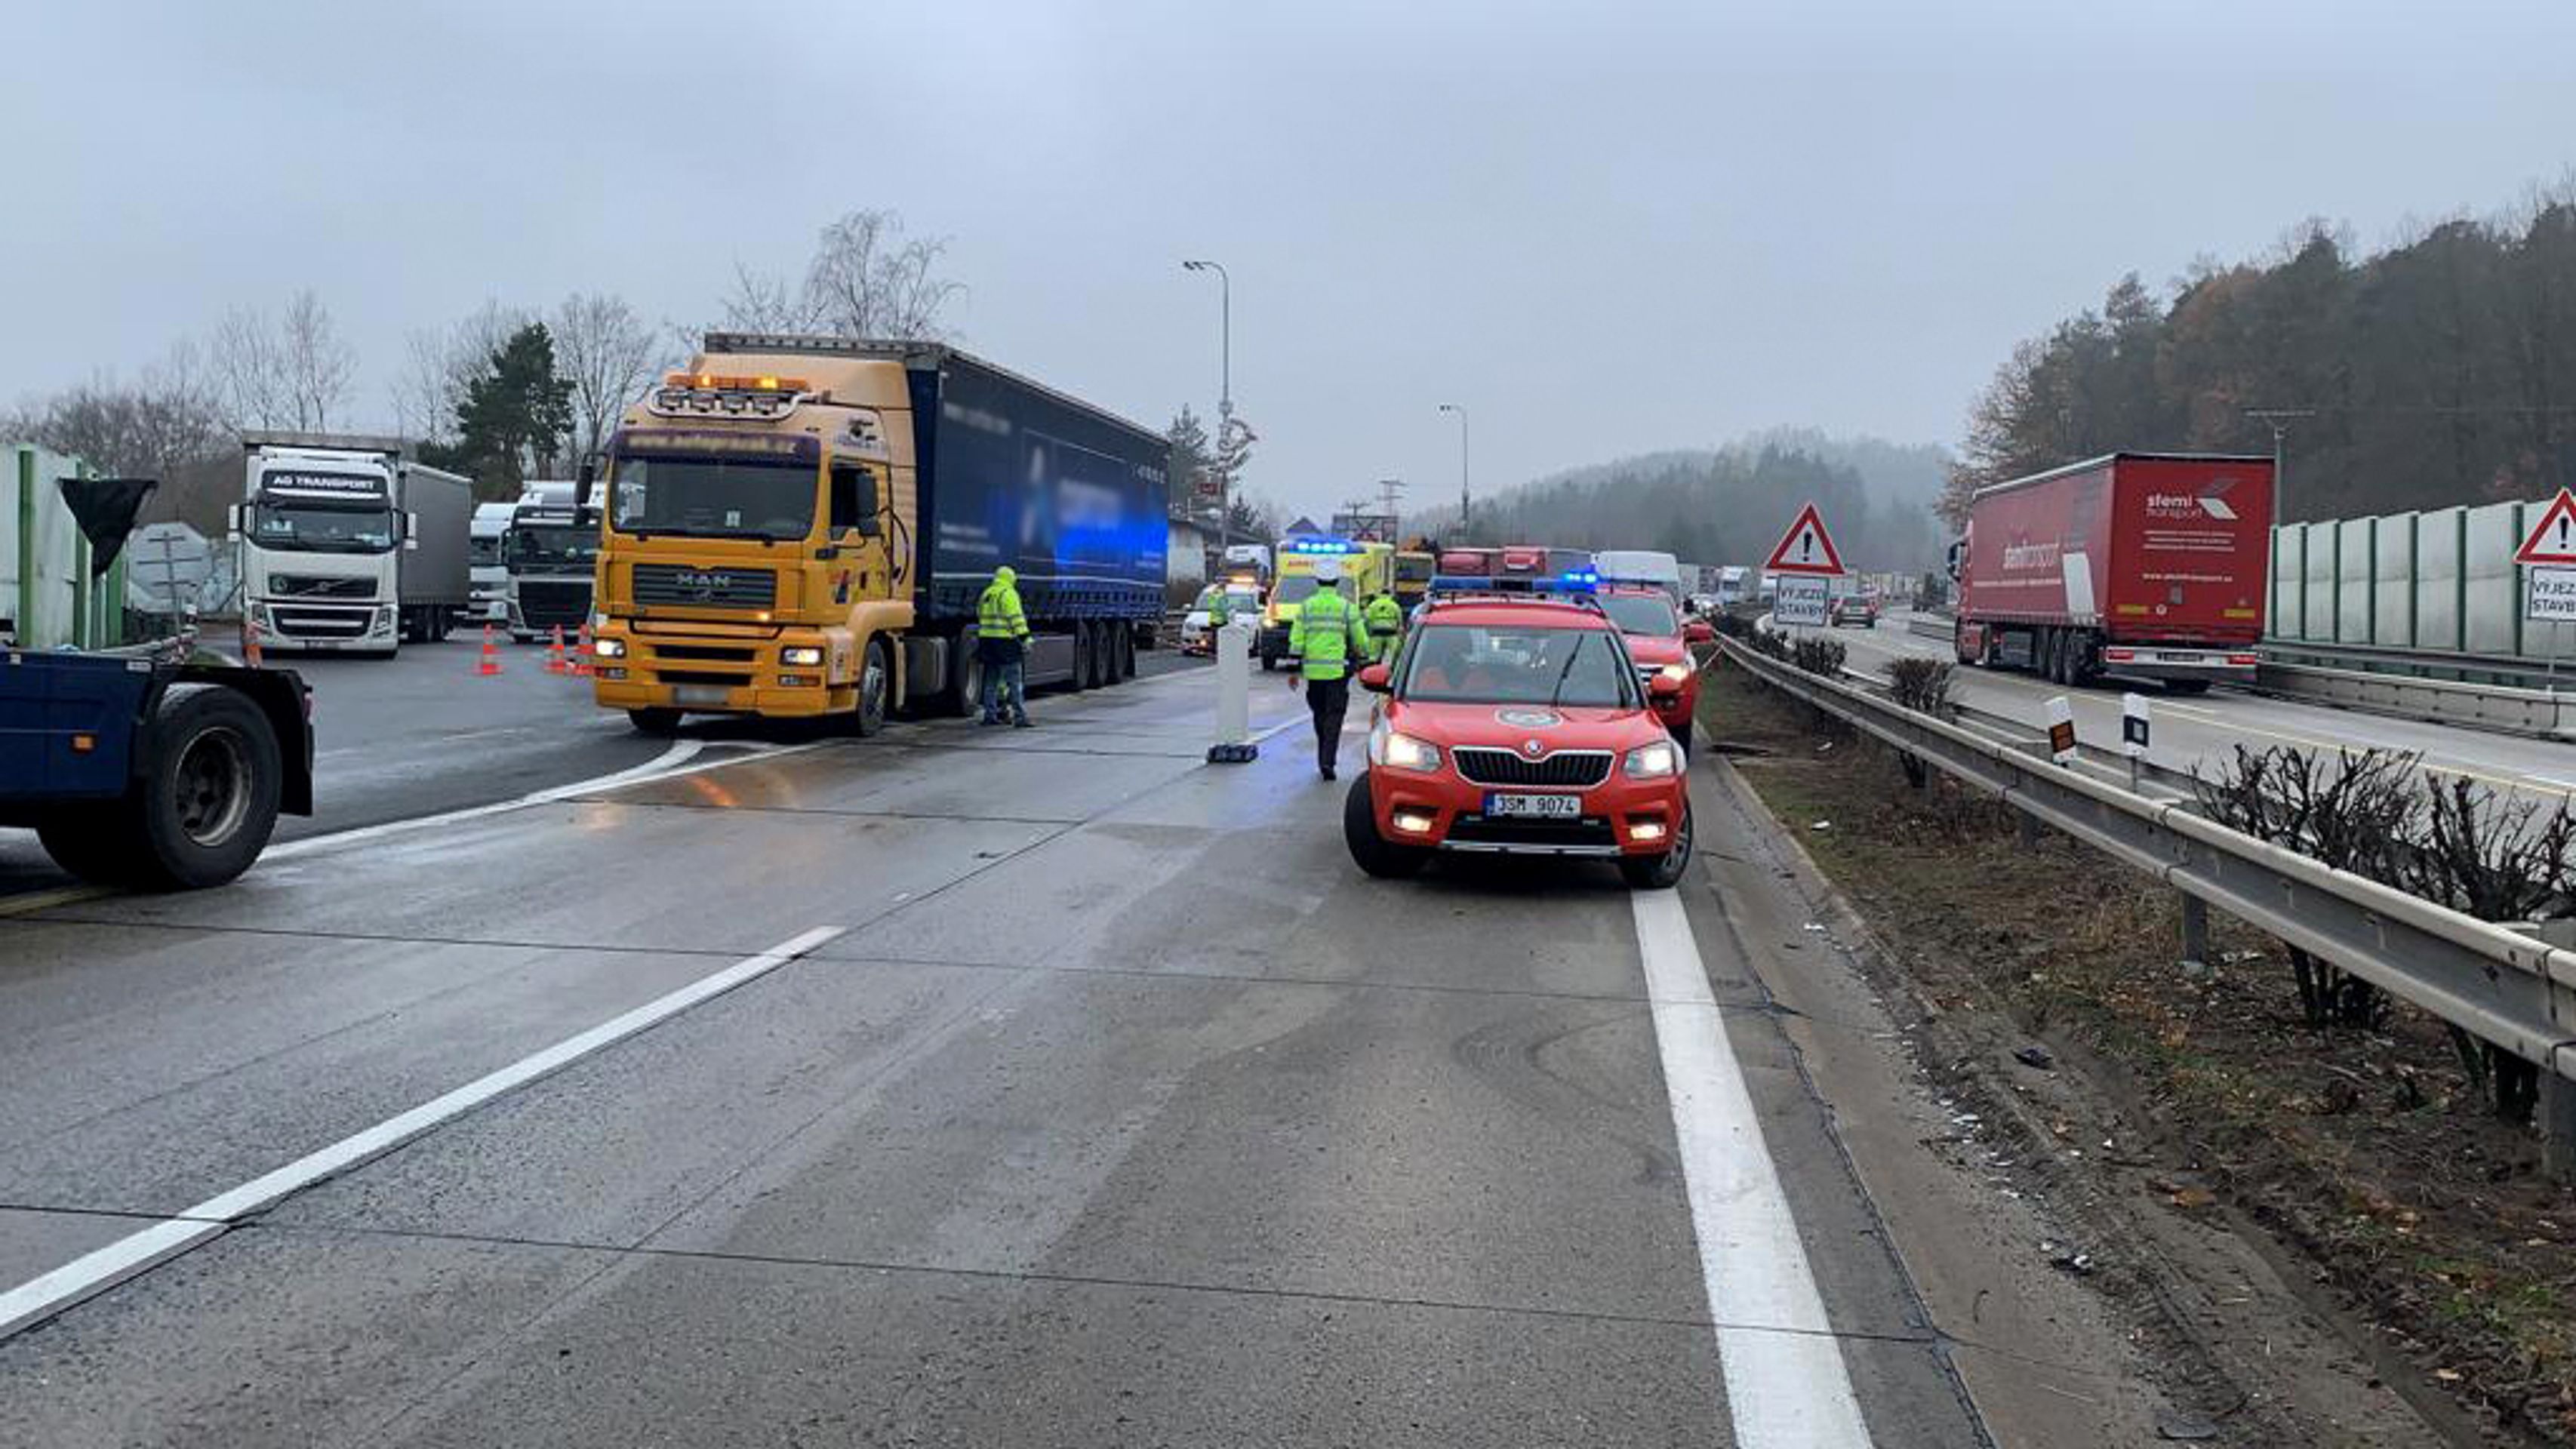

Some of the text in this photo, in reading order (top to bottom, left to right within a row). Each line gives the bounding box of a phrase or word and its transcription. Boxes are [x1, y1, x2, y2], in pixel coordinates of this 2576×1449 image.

[274, 475, 374, 489] AG TRANSPORT
[677, 574, 730, 587] MAN
[1777, 603, 1824, 617] STAVBY
[1498, 797, 1525, 811] 3SM
[1537, 797, 1574, 811] 9074
